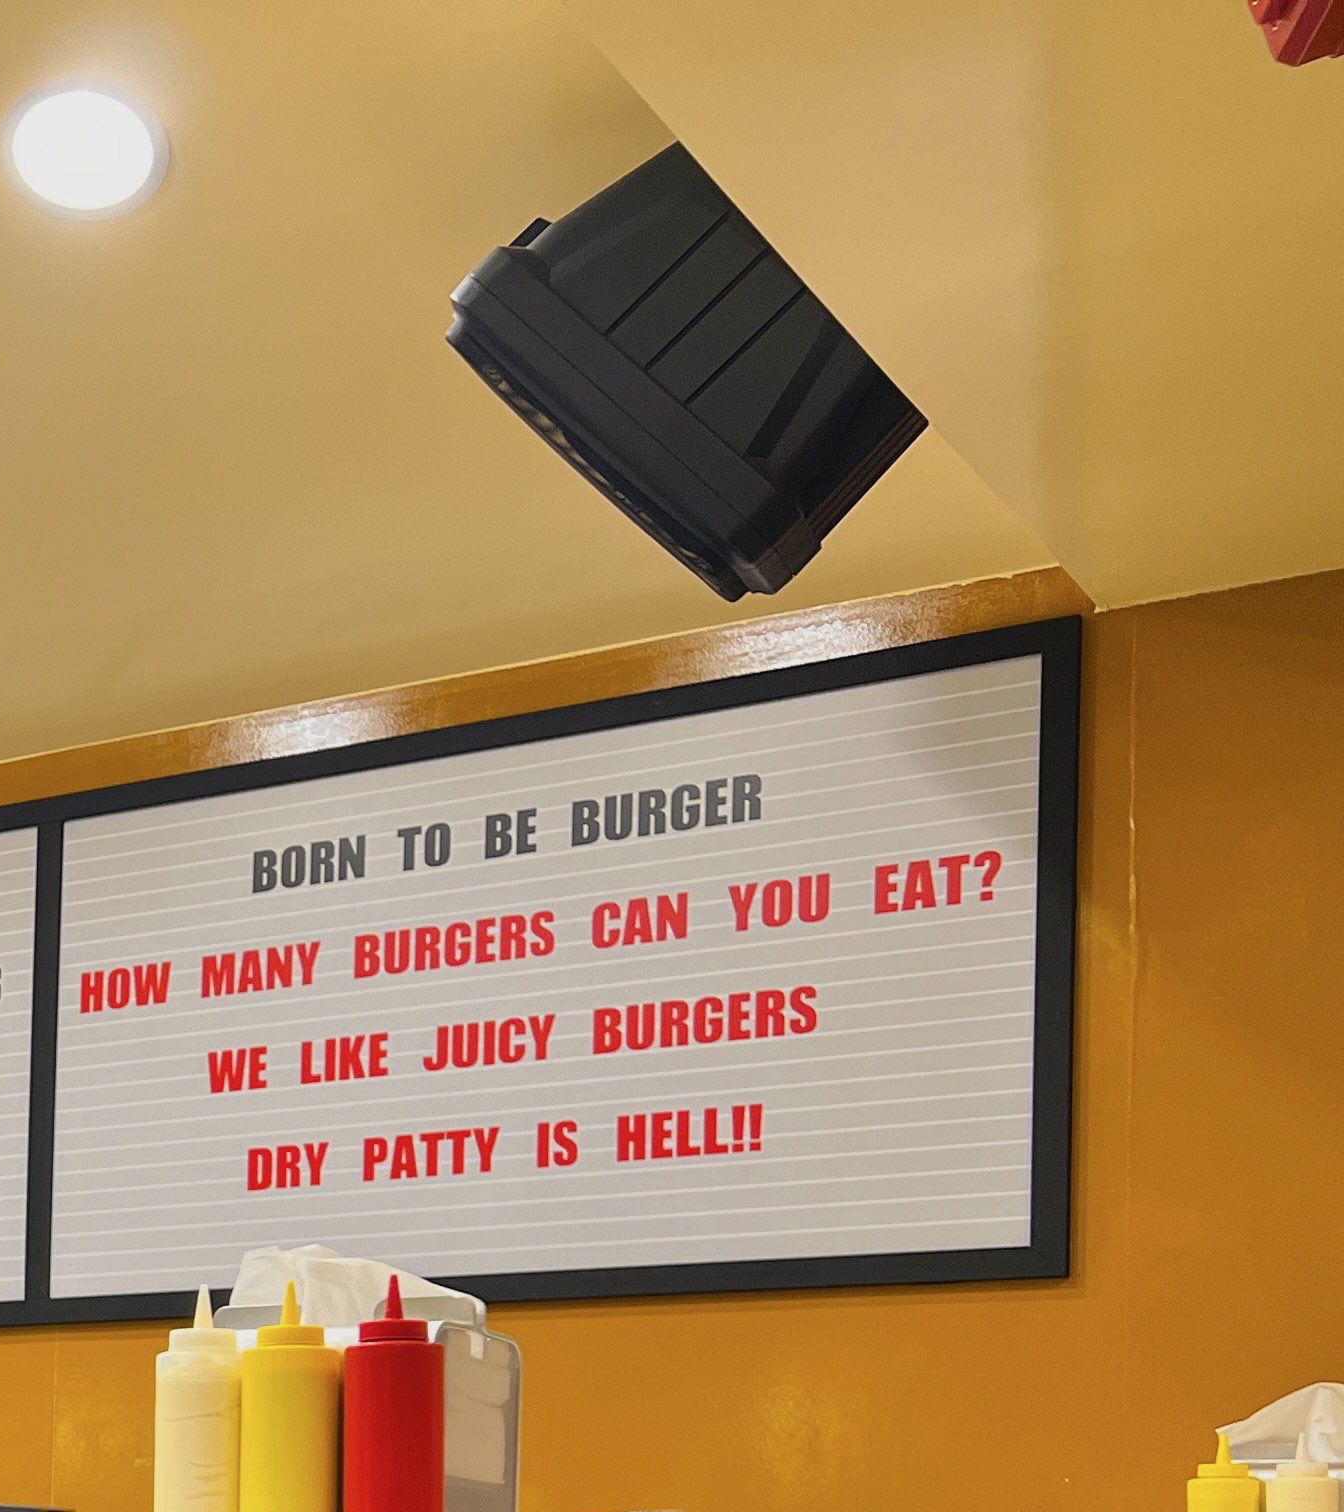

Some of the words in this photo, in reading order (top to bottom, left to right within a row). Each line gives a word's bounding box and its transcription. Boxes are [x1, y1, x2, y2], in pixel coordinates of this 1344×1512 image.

[252, 835, 365, 893] BORN
[397, 823, 450, 871] TO
[485, 808, 536, 859] BE
[571, 775, 761, 847] BURGER
[81, 962, 170, 1013] HOW
[202, 942, 319, 998] MANY
[355, 912, 554, 979] BURGERS
[592, 893, 688, 948] CAN
[730, 874, 830, 931] YOU
[875, 851, 1002, 914] EAT?
[209, 1047, 266, 1093] WE
[301, 1034, 388, 1084] LIKE
[423, 1015, 554, 1071] JUICY
[593, 986, 817, 1054] BURGERS
[248, 1143, 328, 1190] DRY
[364, 1127, 499, 1181] PATTY
[538, 1121, 577, 1167] IS
[618, 1104, 762, 1161] HELL!!
